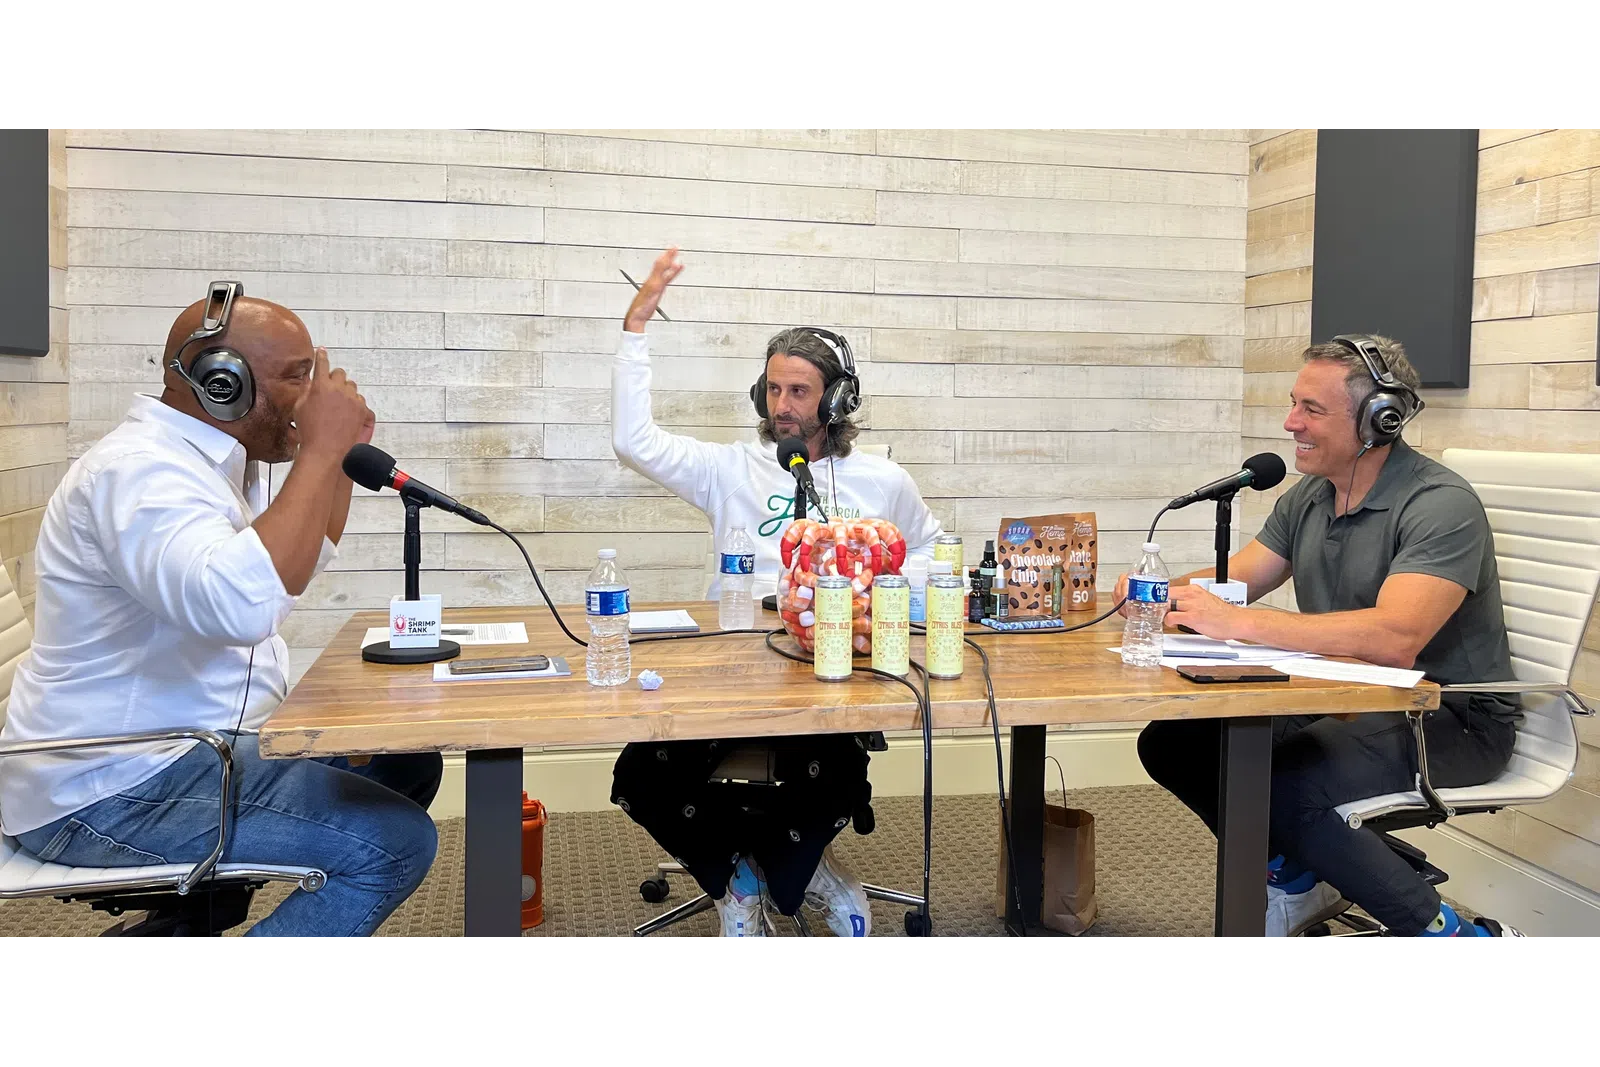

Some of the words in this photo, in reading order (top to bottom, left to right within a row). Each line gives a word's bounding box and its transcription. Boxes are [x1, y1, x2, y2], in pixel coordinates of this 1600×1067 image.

[817, 507, 860, 519] GEORGIA
[1008, 526, 1031, 535] SUGAR
[1010, 553, 1062, 568] Chocolate
[1069, 550, 1091, 563] late
[1011, 569, 1038, 584] Chip
[1072, 590, 1089, 604] 50
[1156, 589, 1167, 597] Life
[408, 620, 436, 628] SHRIMP
[819, 621, 837, 630] CITRUS
[877, 620, 896, 630] CITRUS
[931, 620, 949, 630] CITRUS
